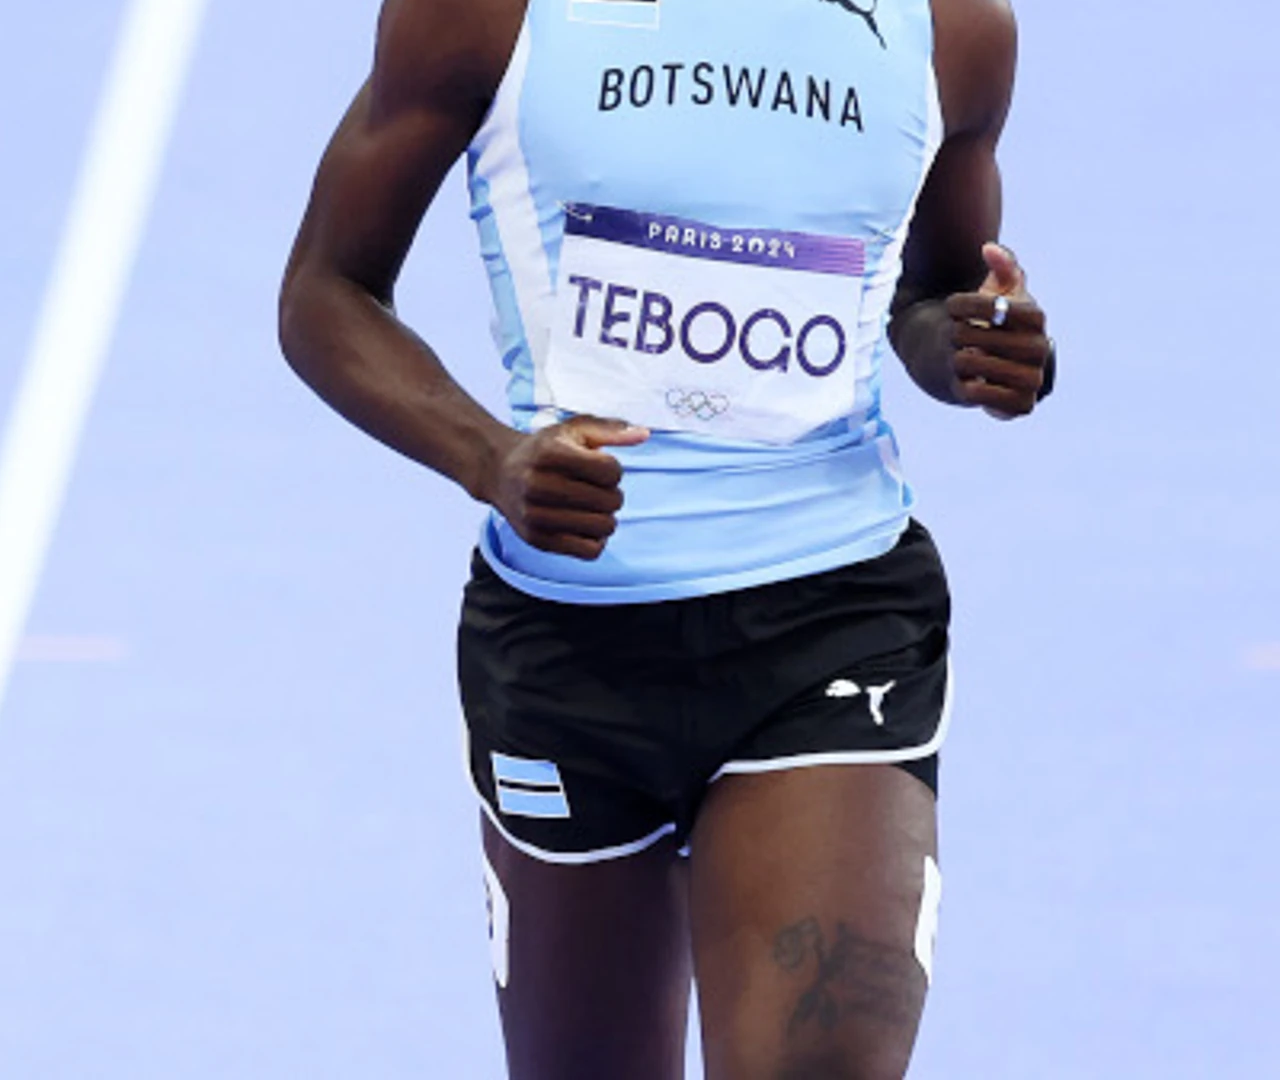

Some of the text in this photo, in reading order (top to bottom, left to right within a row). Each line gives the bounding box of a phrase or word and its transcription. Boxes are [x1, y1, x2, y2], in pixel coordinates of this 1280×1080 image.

[598, 62, 864, 133] BOTSWANA
[648, 222, 796, 259] PARIS 2024
[567, 275, 848, 377] TEBOGO
